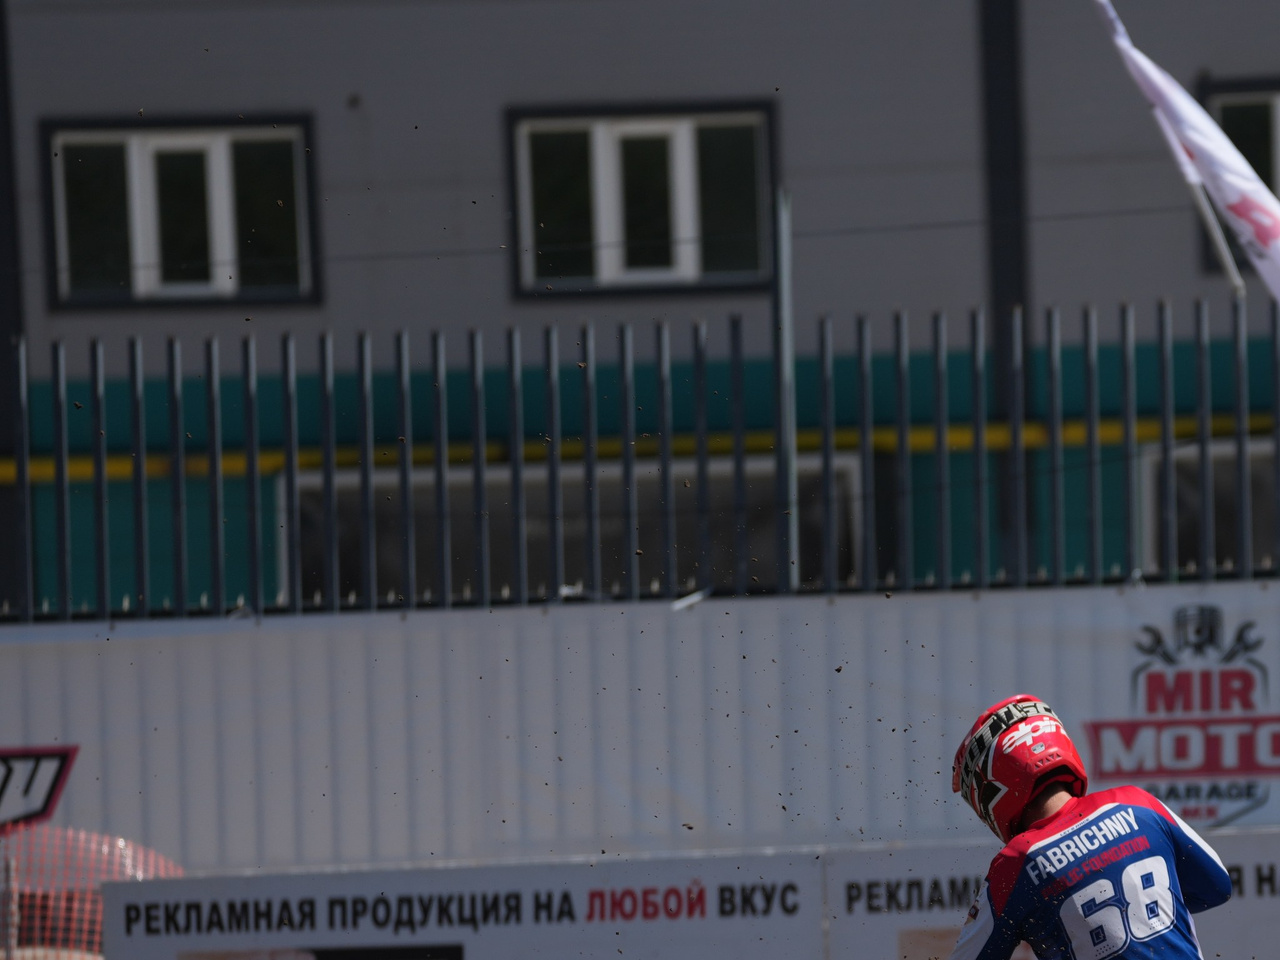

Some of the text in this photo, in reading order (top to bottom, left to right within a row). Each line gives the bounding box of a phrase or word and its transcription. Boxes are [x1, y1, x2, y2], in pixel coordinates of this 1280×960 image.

[1145, 669, 1257, 714] MIR
[1025, 807, 1139, 886] FABRICHNIY
[1081, 834, 1151, 875] FOUNDATION
[125, 878, 799, 937] РЕКЛАМНАЯ ПРОДУКЦИЯ НА ЛЮБОЙ ВКУС
